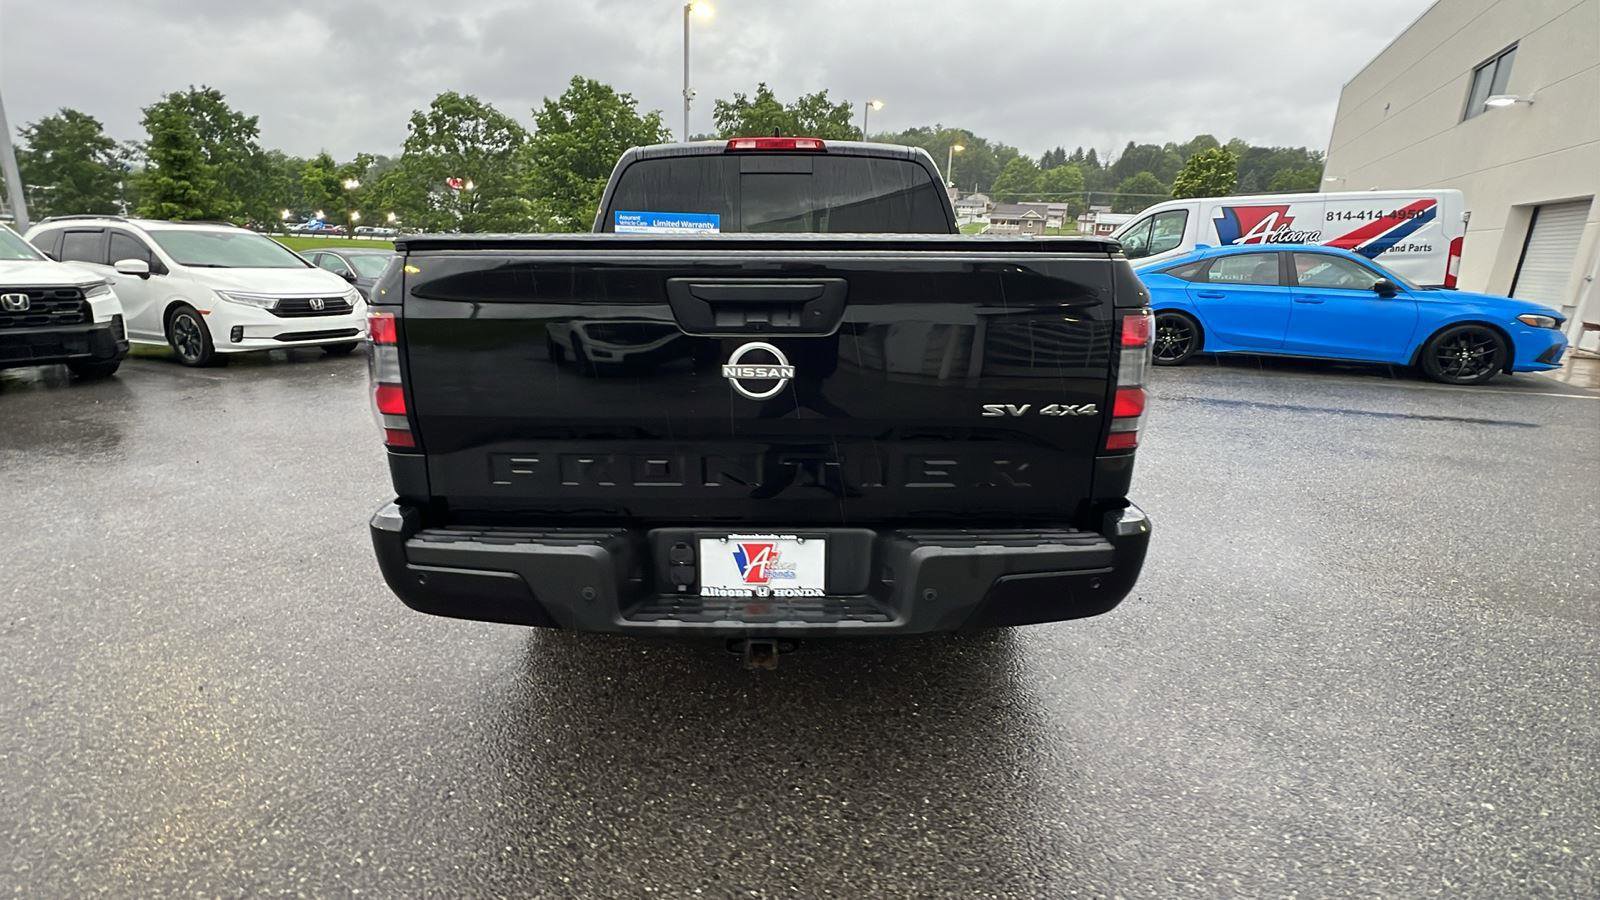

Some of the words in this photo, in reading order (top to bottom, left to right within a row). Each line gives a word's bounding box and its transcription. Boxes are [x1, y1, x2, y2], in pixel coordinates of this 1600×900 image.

[1326, 209, 1425, 222] 814-414-4950
[653, 219, 680, 227] Limited
[680, 221, 715, 229] Warranty
[1232, 211, 1321, 245] Altoona
[1390, 244, 1406, 252] and
[1408, 243, 1432, 252] Parts
[723, 367, 794, 377] NISSAN
[981, 404, 1031, 417] SV
[490, 453, 1033, 488] FRONTIER
[773, 588, 825, 597] HONDA
